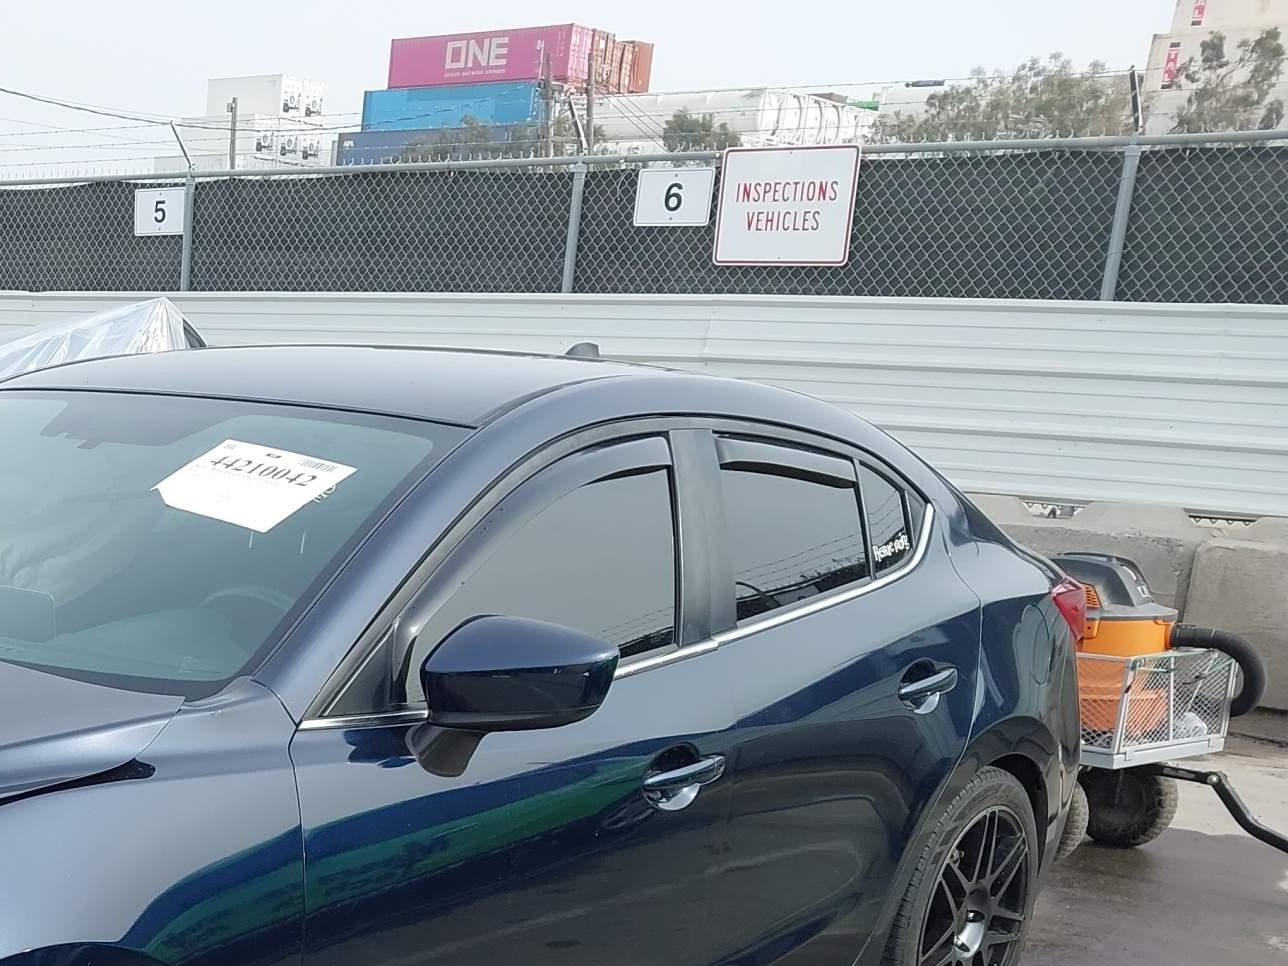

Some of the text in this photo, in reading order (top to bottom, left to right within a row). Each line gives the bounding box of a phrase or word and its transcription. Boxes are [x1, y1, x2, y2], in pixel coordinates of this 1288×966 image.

[445, 37, 509, 69] ONE
[664, 182, 683, 211] 6
[736, 181, 838, 202] INSPECTIONS
[154, 200, 166, 223] 5
[746, 211, 821, 231] VEHICLES
[210, 455, 318, 486] 44210042
